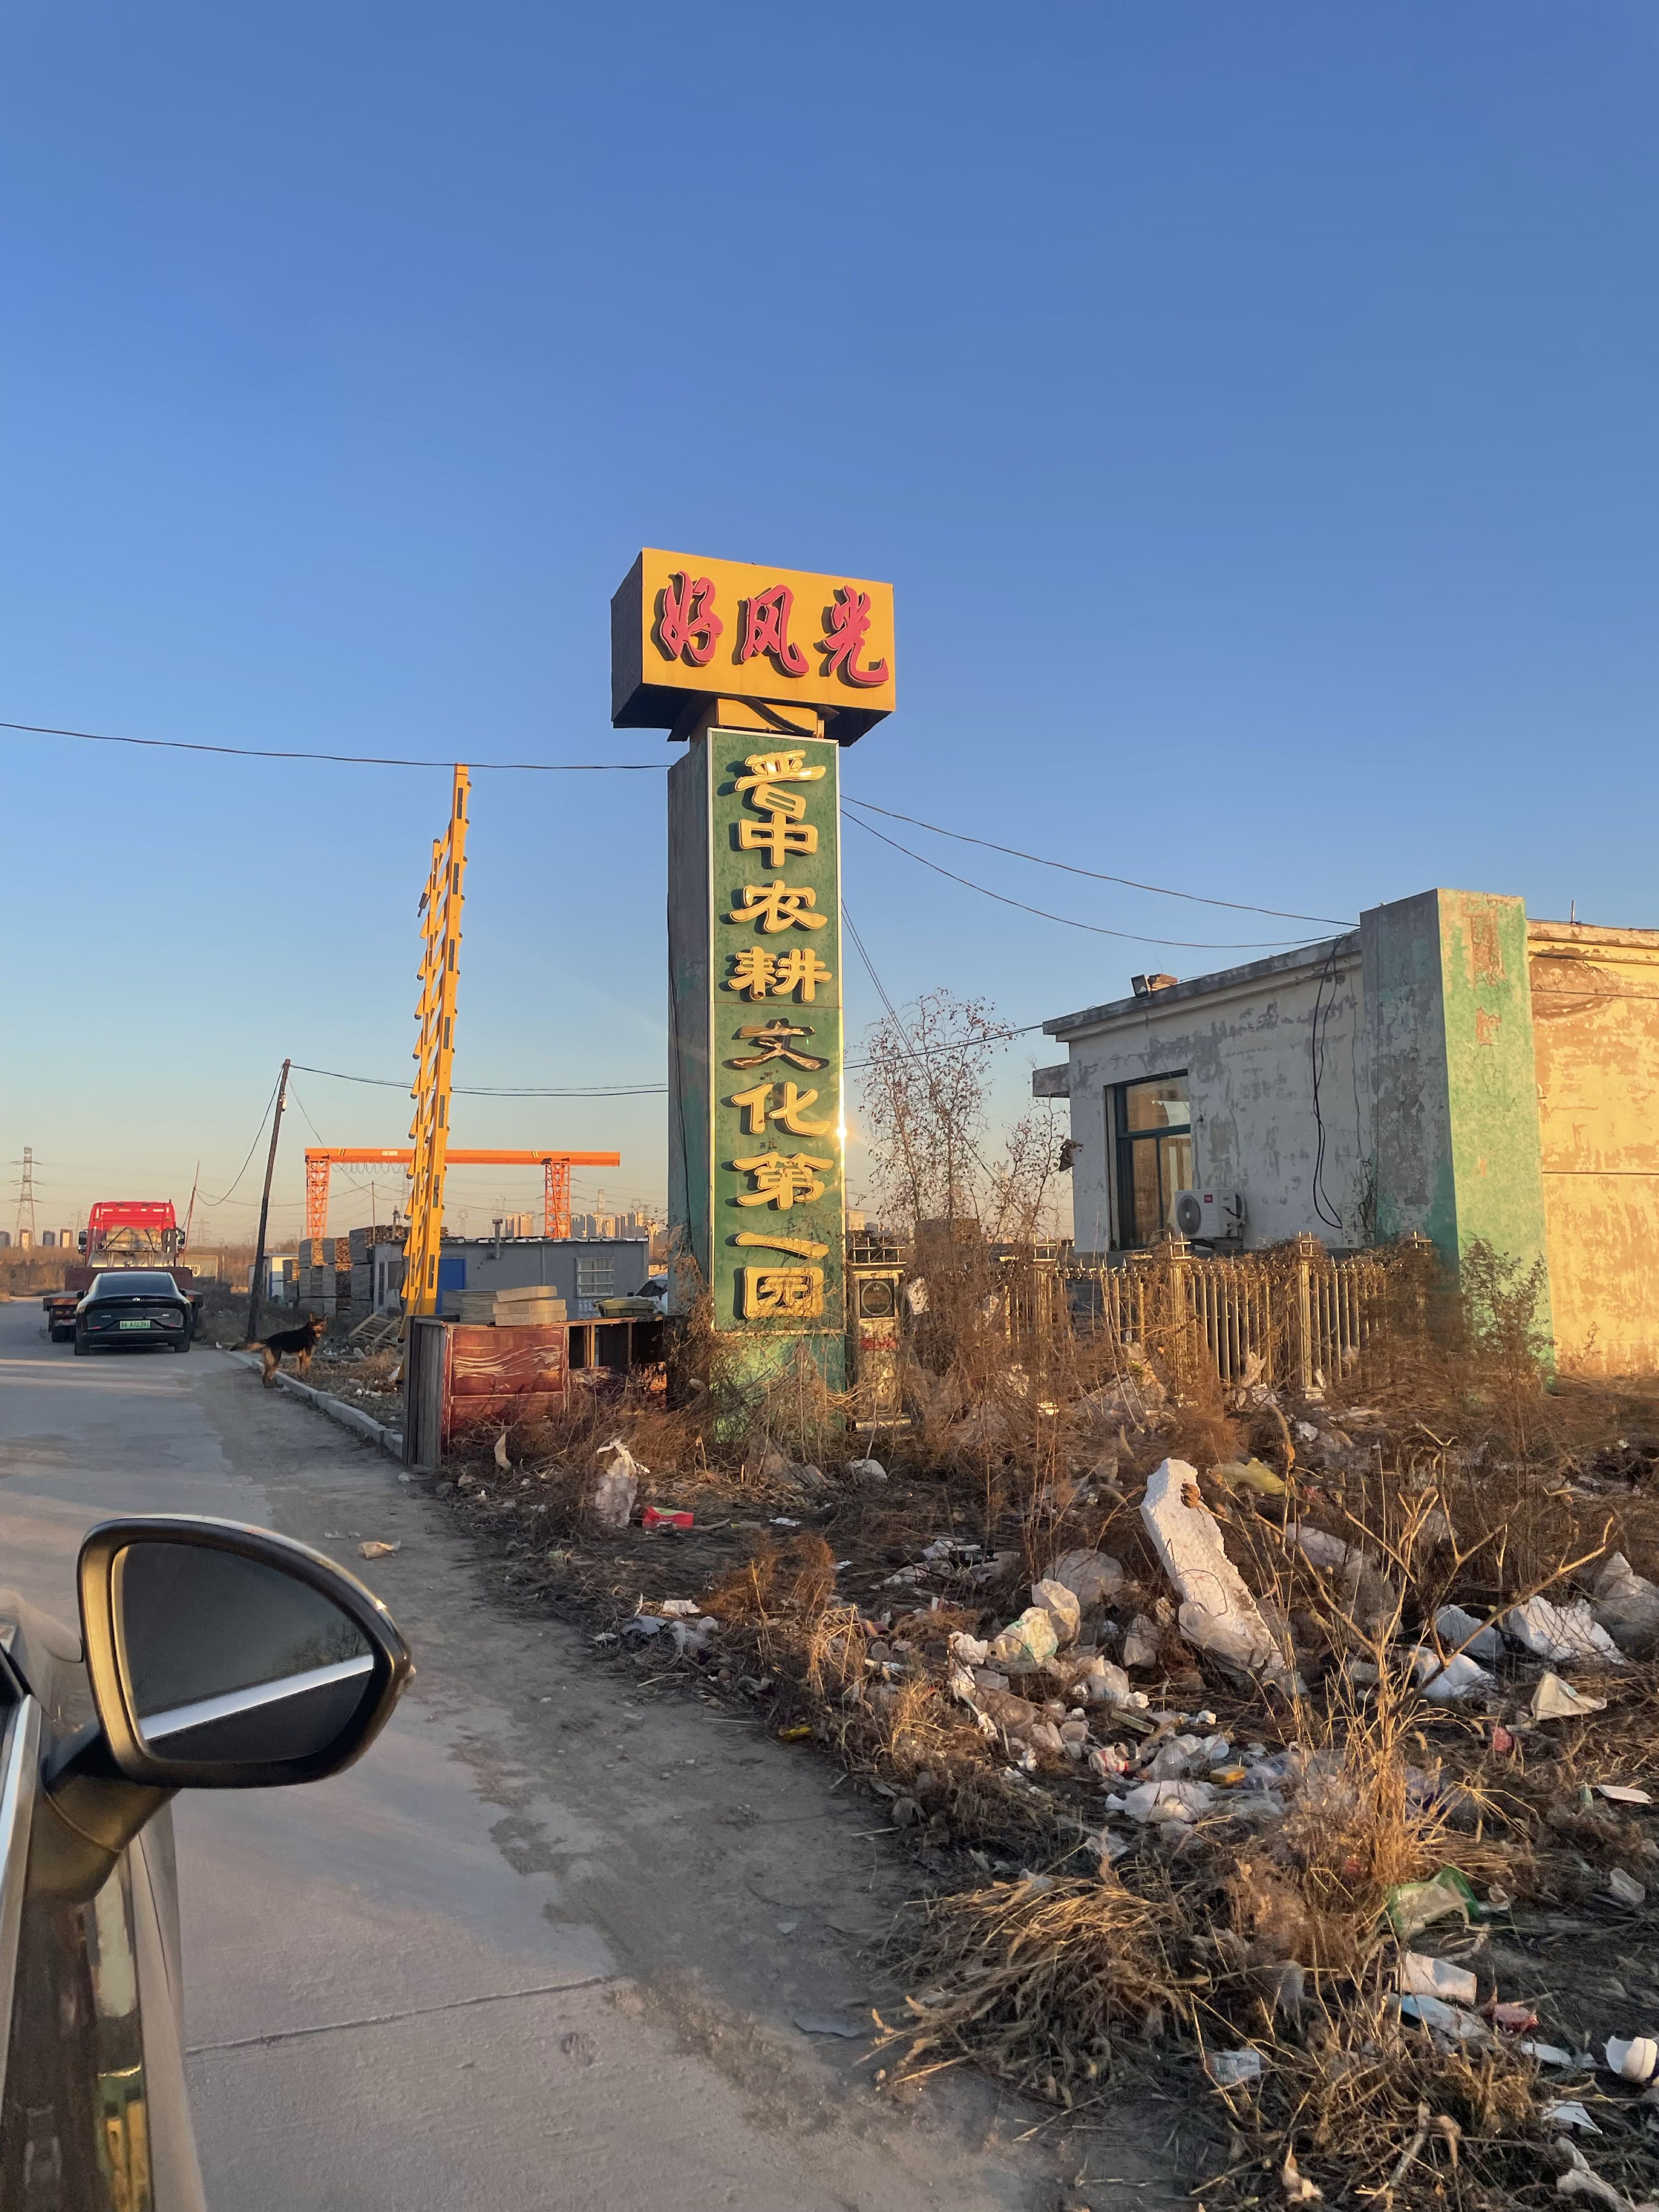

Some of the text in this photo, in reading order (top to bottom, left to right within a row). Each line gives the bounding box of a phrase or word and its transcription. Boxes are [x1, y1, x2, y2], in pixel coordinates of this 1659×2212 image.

[656, 570, 889, 685] 好风光
[729, 749, 833, 1319] 晋中农耕文化第一园
